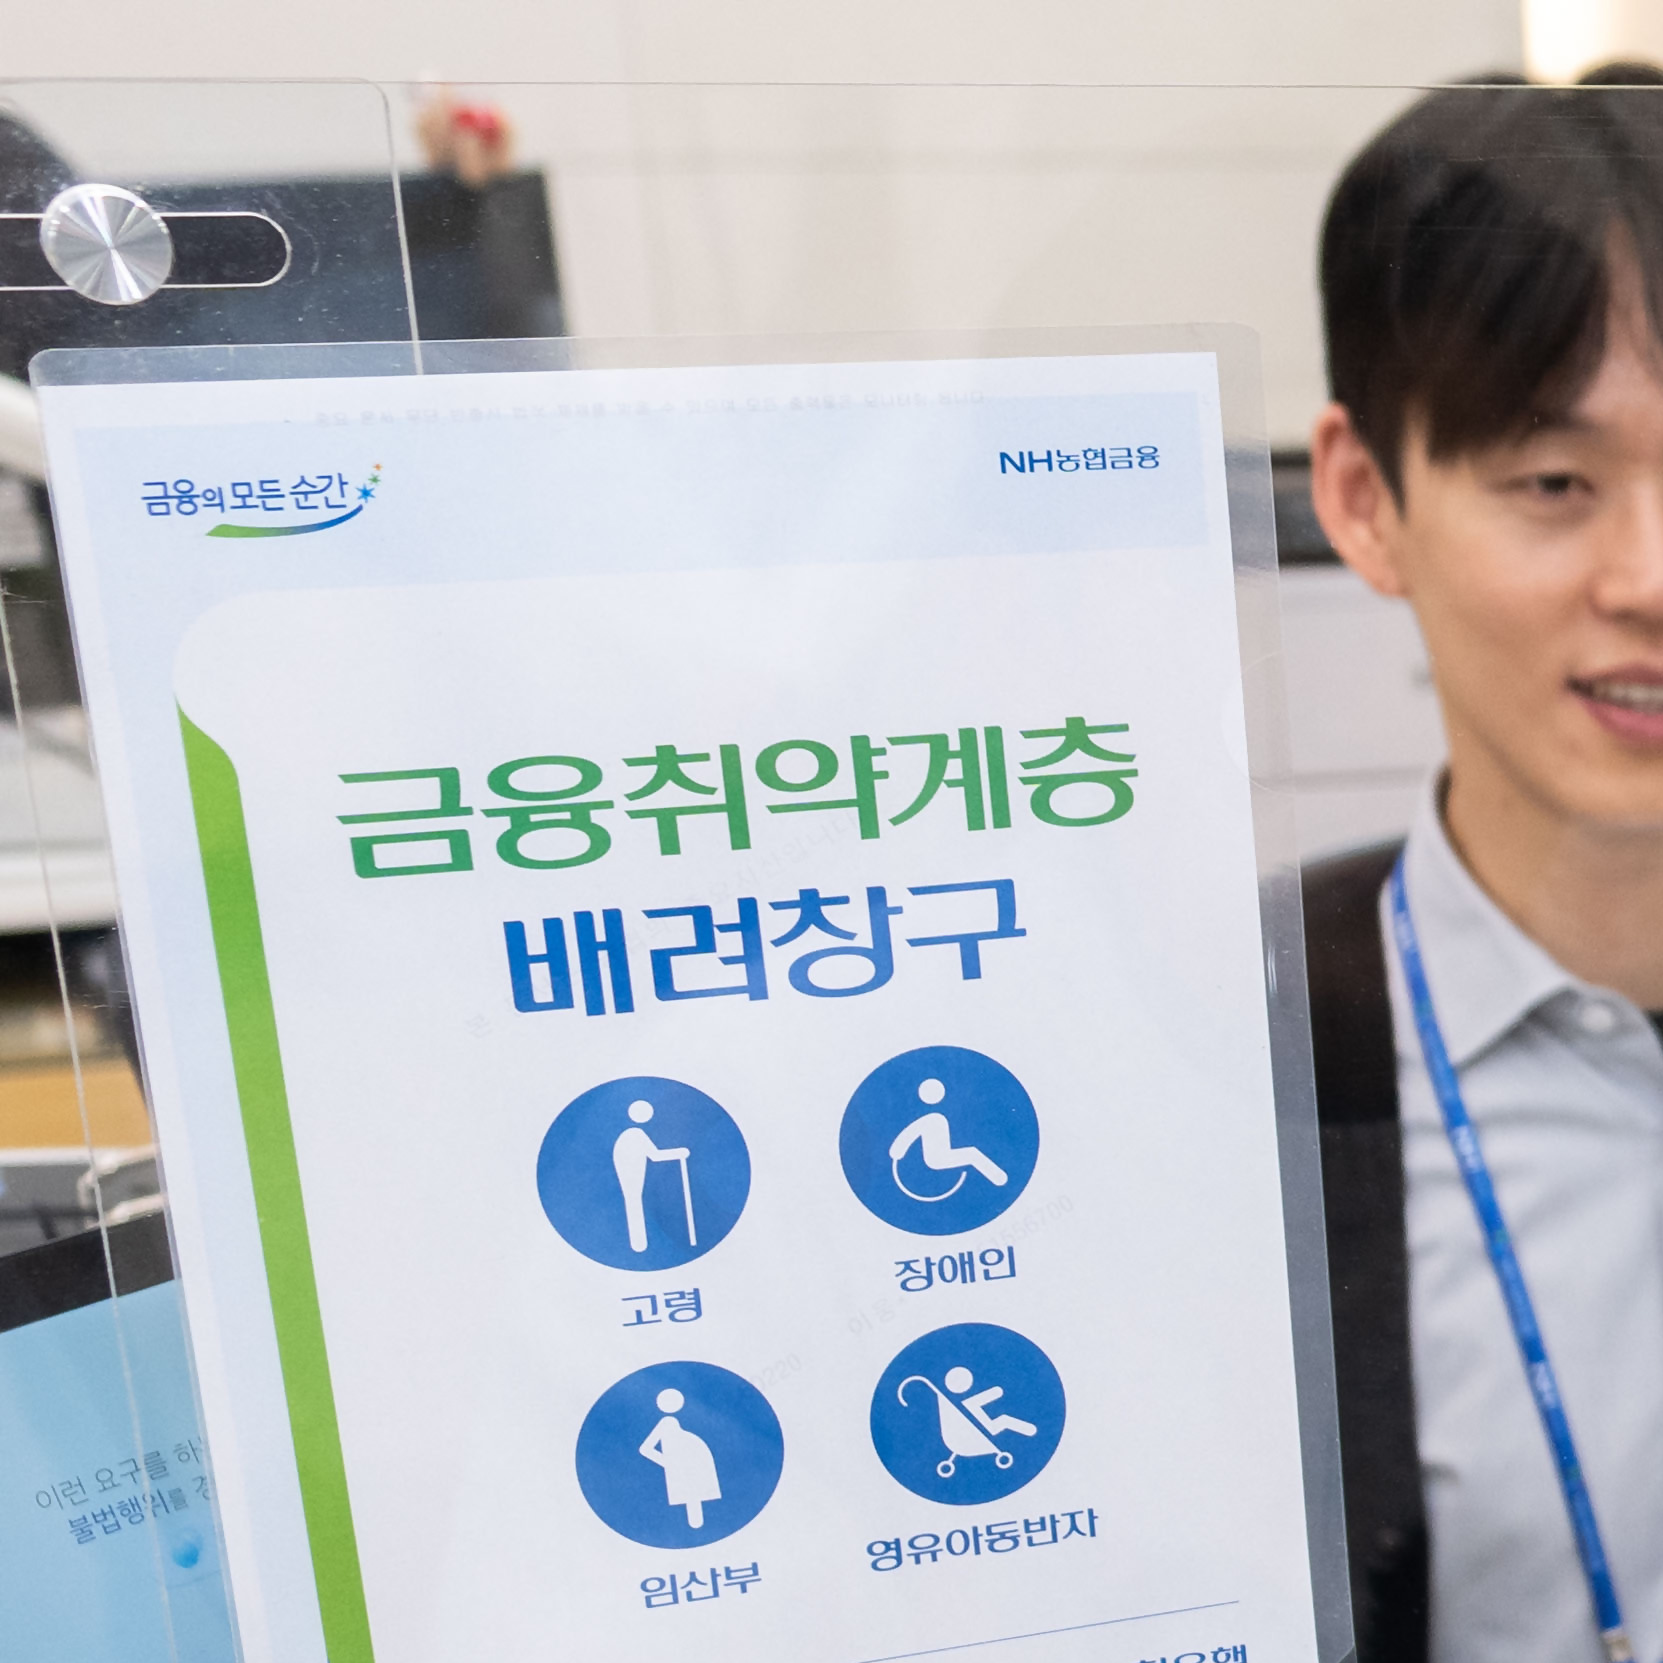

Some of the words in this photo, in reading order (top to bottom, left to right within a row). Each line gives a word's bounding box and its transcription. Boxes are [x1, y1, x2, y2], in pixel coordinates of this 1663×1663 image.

[998, 445, 1160, 474] NH농협금융
[141, 478, 225, 516] 금융의
[230, 479, 286, 512] 모든
[289, 472, 349, 510] 순간
[335, 716, 1139, 880] 금융취약계층
[502, 878, 1027, 1017] 배려창구
[894, 1246, 1017, 1292] 장애인
[621, 1287, 703, 1327] 고령
[35, 1475, 89, 1510] 이런
[95, 1450, 170, 1493] 요구를
[68, 1487, 189, 1545] 불법행위를
[865, 1508, 1099, 1572] 영유아동반자
[640, 1562, 763, 1609] 임산부
